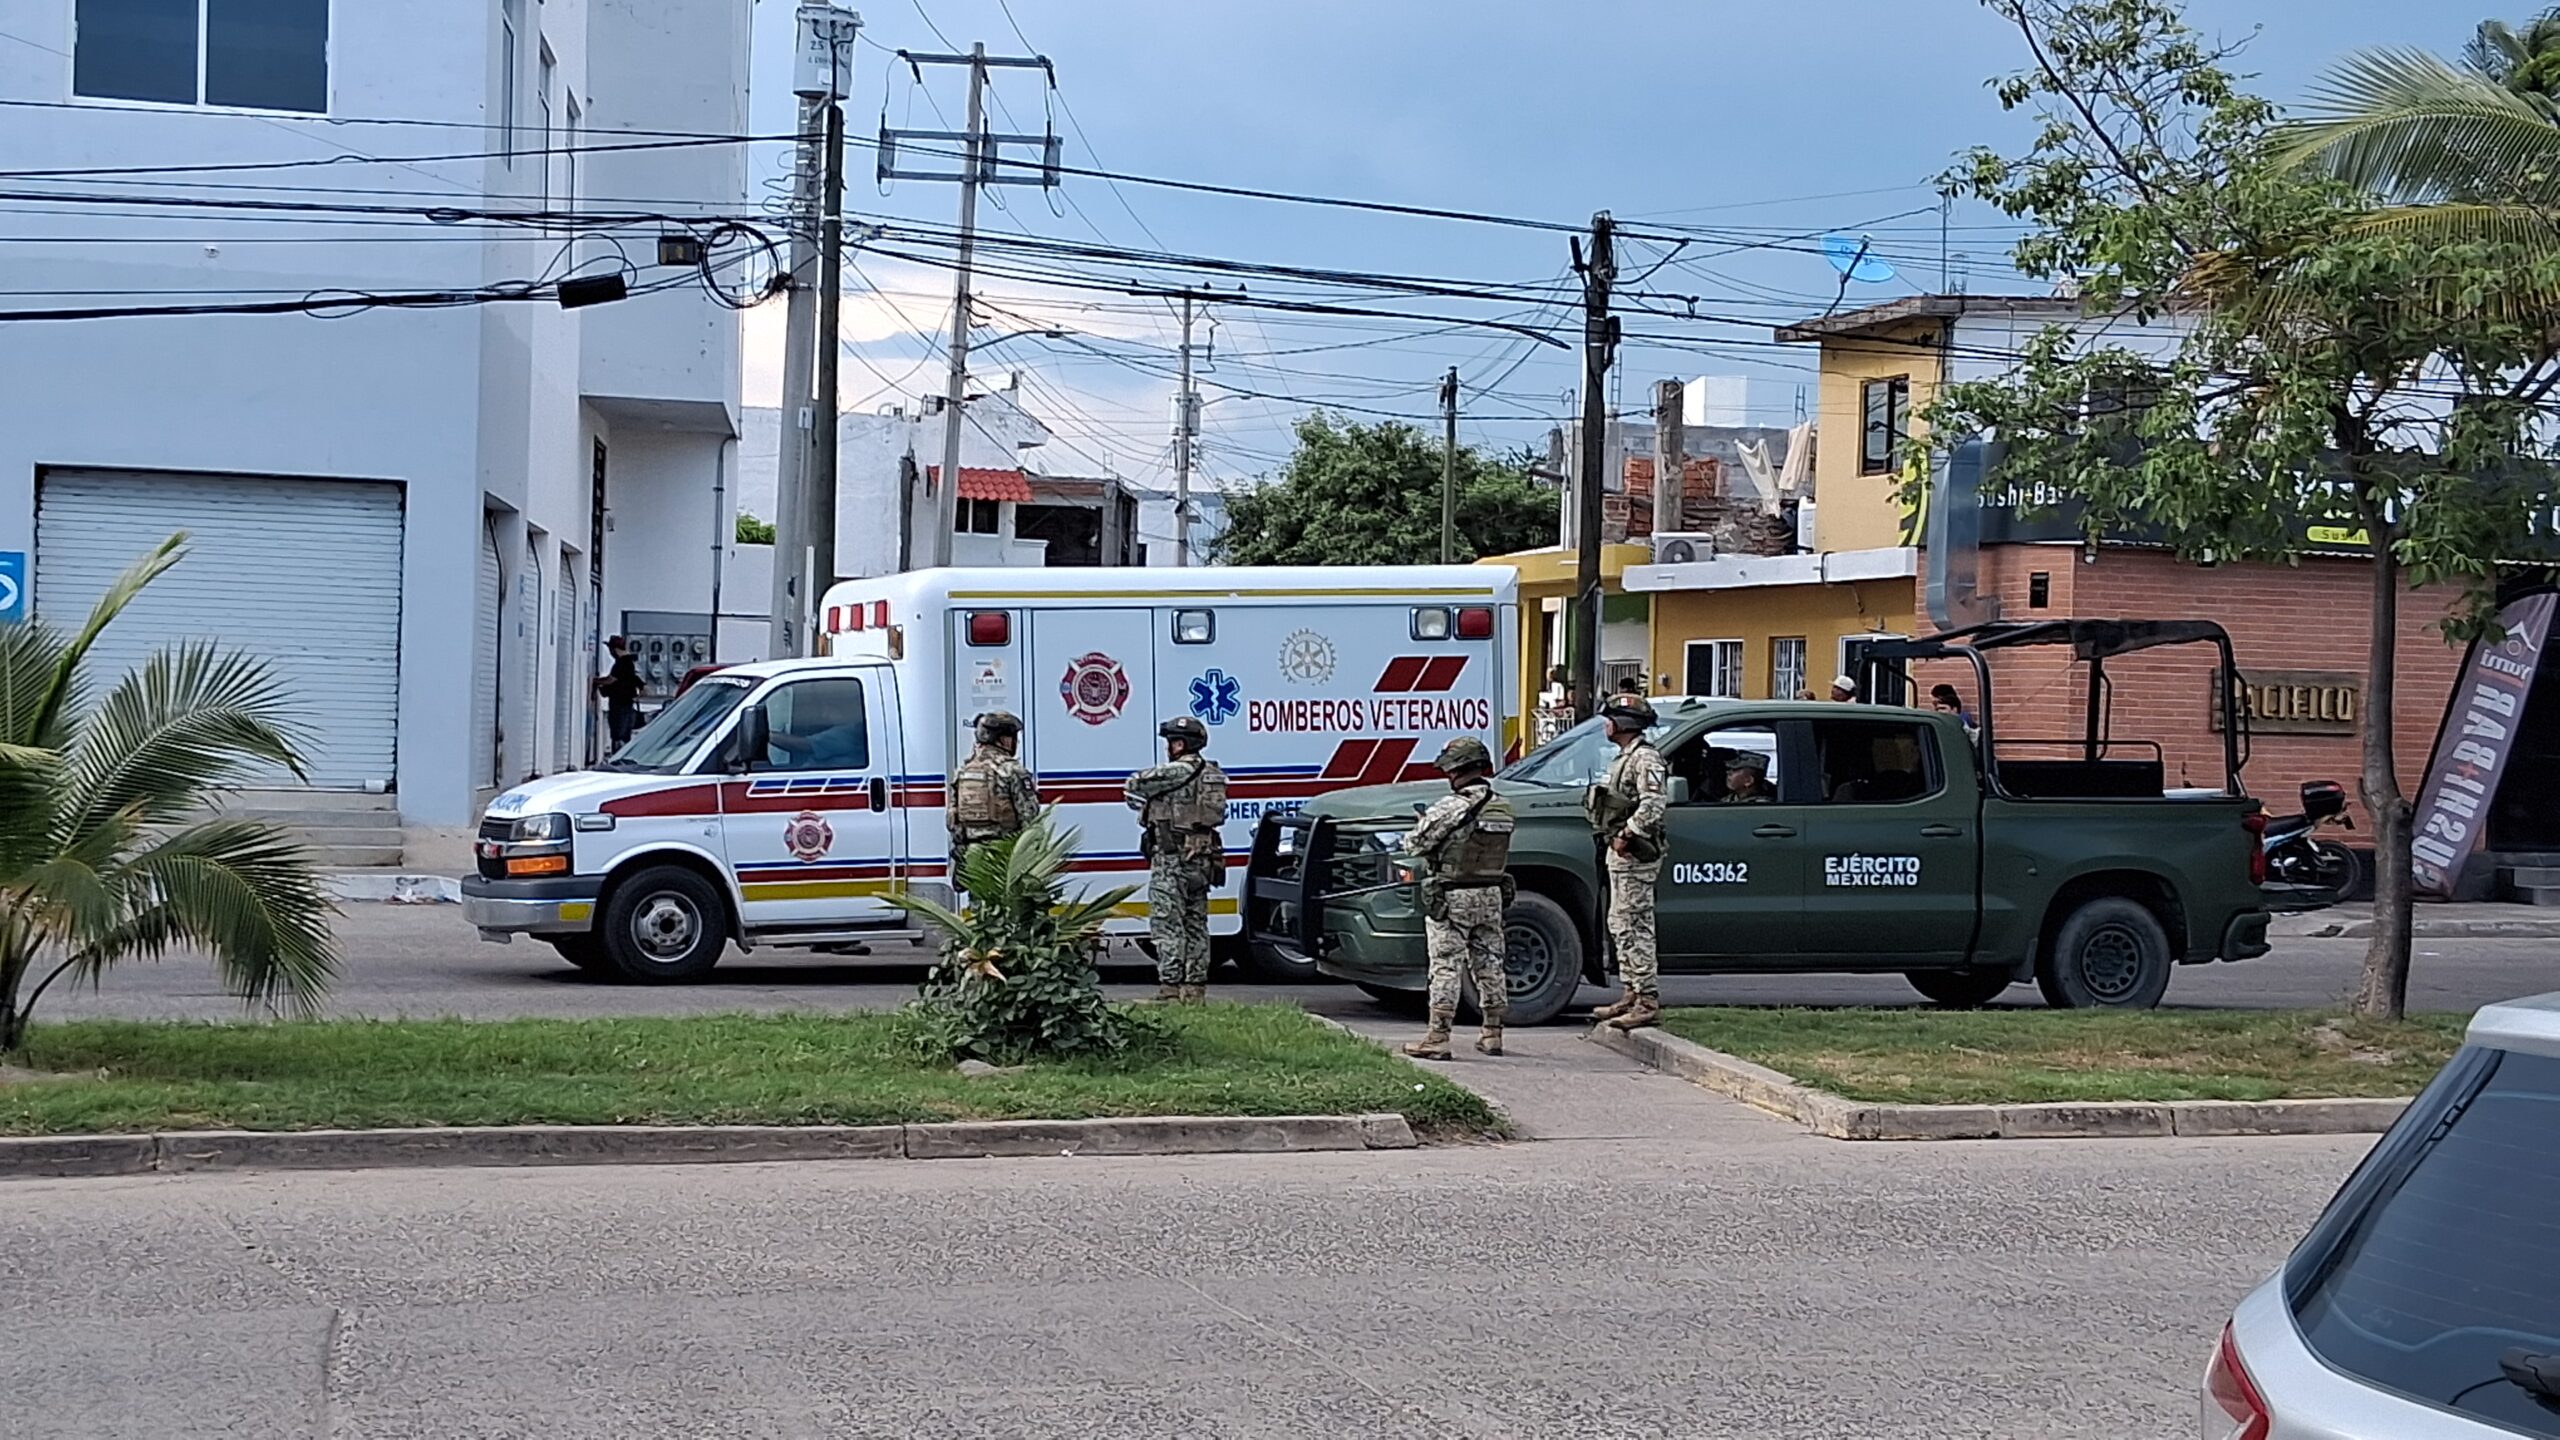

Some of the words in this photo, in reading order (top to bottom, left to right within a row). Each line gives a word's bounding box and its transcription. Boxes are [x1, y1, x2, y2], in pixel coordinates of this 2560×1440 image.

[2320, 529, 2364, 541] Susi
[1249, 700, 1364, 732] BOMBEROS
[1369, 698, 1489, 731] VETERANOS
[1673, 862, 1748, 883] 0163362
[1824, 852, 1921, 874] EJÉRCITO
[1826, 873, 1918, 887] MEXICANO
